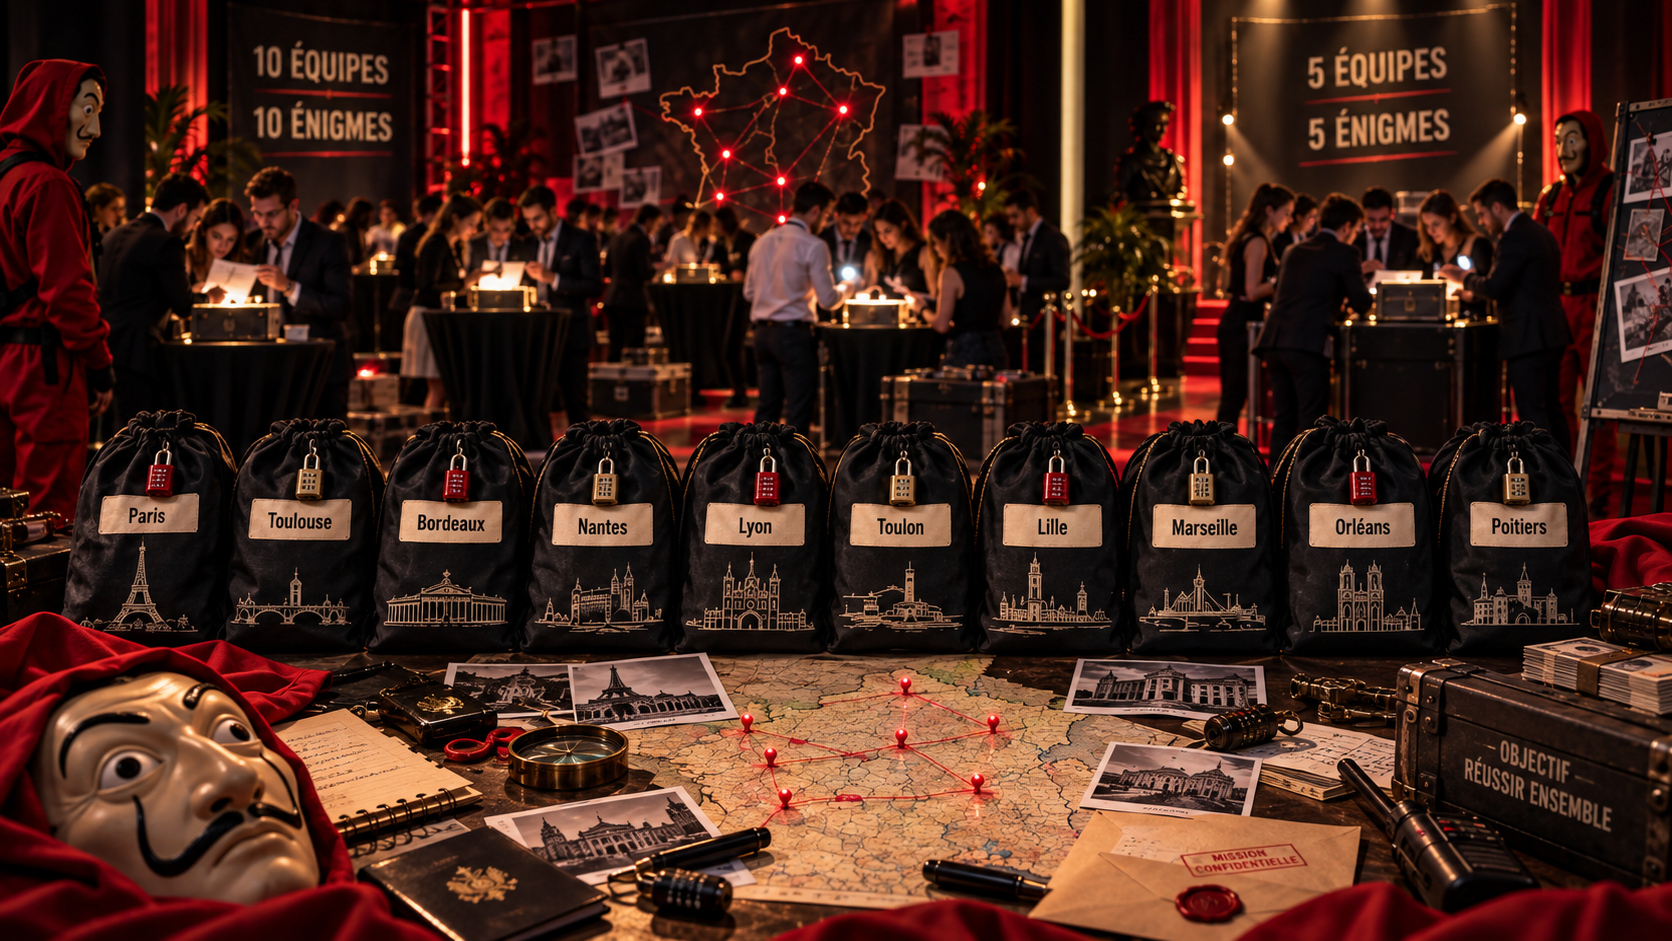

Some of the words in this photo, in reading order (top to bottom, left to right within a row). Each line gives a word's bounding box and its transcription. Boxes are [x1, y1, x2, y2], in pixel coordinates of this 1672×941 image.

[253, 45, 282, 78] 10
[291, 41, 388, 84] ÉQUIPES
[1308, 56, 1325, 89] 5
[1334, 46, 1447, 88] ÉQUIPES
[253, 106, 283, 139] 10
[291, 101, 392, 142] ÉNIGMES
[1308, 117, 1325, 150] 5
[1335, 108, 1450, 148] ÉNIGMES
[129, 507, 165, 523] Paris
[268, 512, 332, 529] Toulouse
[418, 515, 485, 531] Bordeaux
[579, 518, 627, 535] Nantes
[740, 517, 771, 538] Lyon
[877, 518, 923, 535] Toulon
[1038, 518, 1067, 535] Lille
[1173, 519, 1237, 535] Marseille
[1336, 518, 1390, 535] Orléans
[1492, 518, 1547, 534] Poitiers
[1499, 740, 1571, 783] OBJECTIF
[1464, 756, 1524, 801] RÉUSSIR
[1530, 781, 1612, 833] ENSEMBLE
[1212, 849, 1267, 862] MISSION
[1195, 855, 1299, 874] CONFIDENTIELLE
